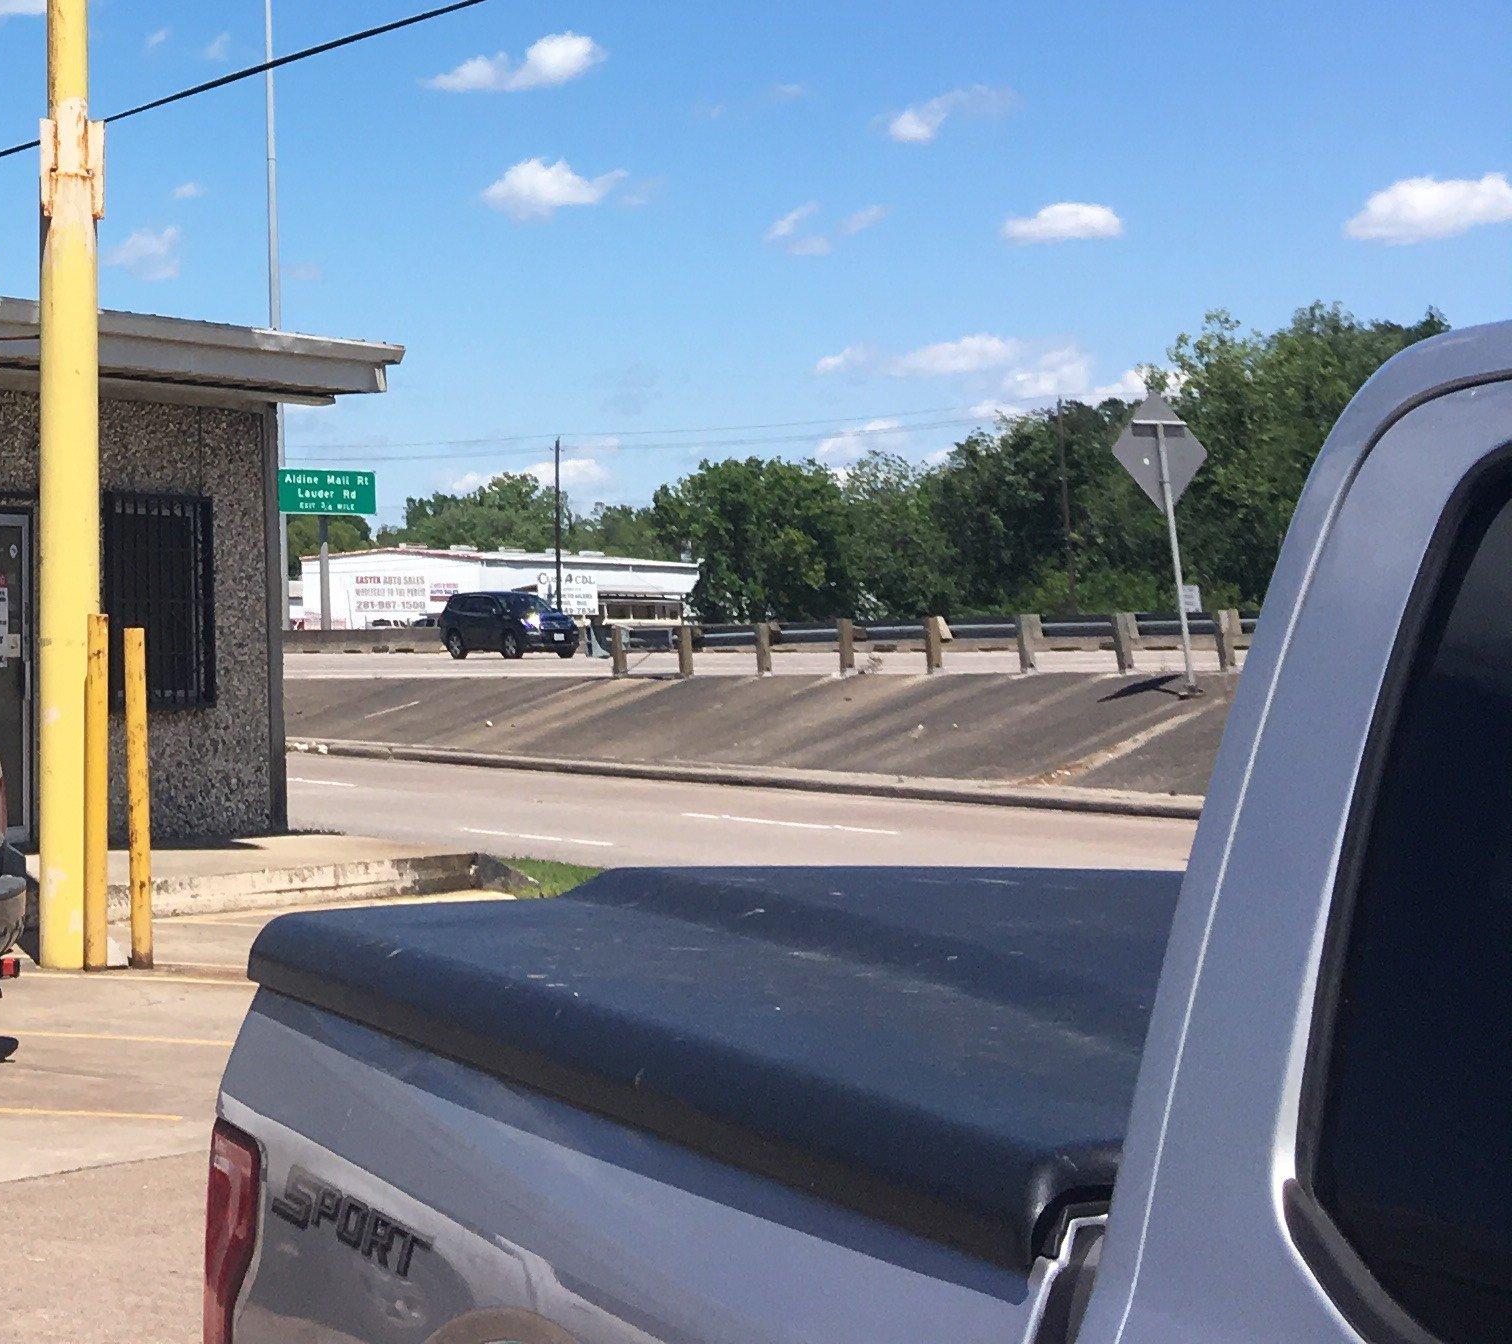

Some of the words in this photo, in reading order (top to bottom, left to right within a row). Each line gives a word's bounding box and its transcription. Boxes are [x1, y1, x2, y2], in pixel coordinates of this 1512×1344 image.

[284, 474, 319, 485] Aldine
[297, 488, 335, 499] Lauder
[342, 489, 357, 499] Rd
[271, 1168, 434, 1278] SPORT
